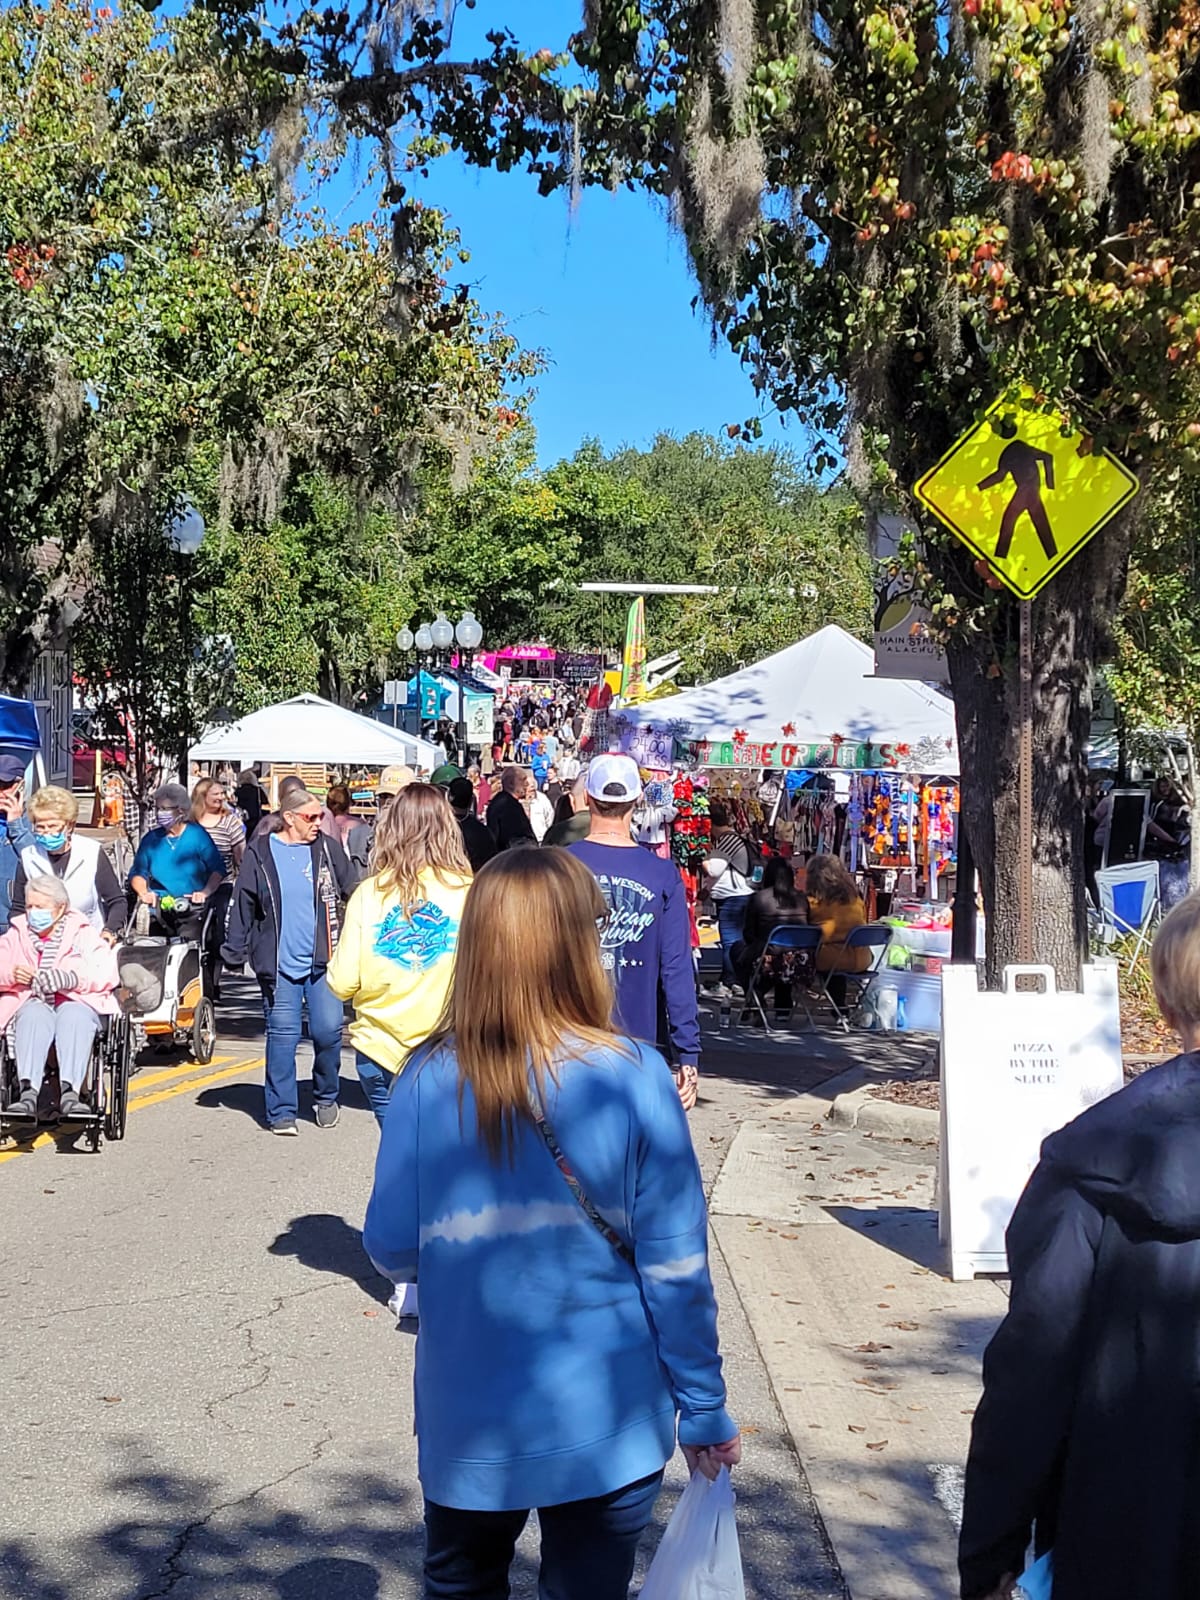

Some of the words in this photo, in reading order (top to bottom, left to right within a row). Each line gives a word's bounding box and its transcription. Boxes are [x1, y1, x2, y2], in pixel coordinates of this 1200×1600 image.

[880, 636, 905, 646] MAIN
[599, 875, 609, 883] &
[611, 875, 656, 902] WESSON
[1013, 1043, 1054, 1052] PIZZA
[1010, 1059, 1027, 1068] BY
[1029, 1059, 1060, 1068] THE
[1014, 1074, 1056, 1084] SLICE
